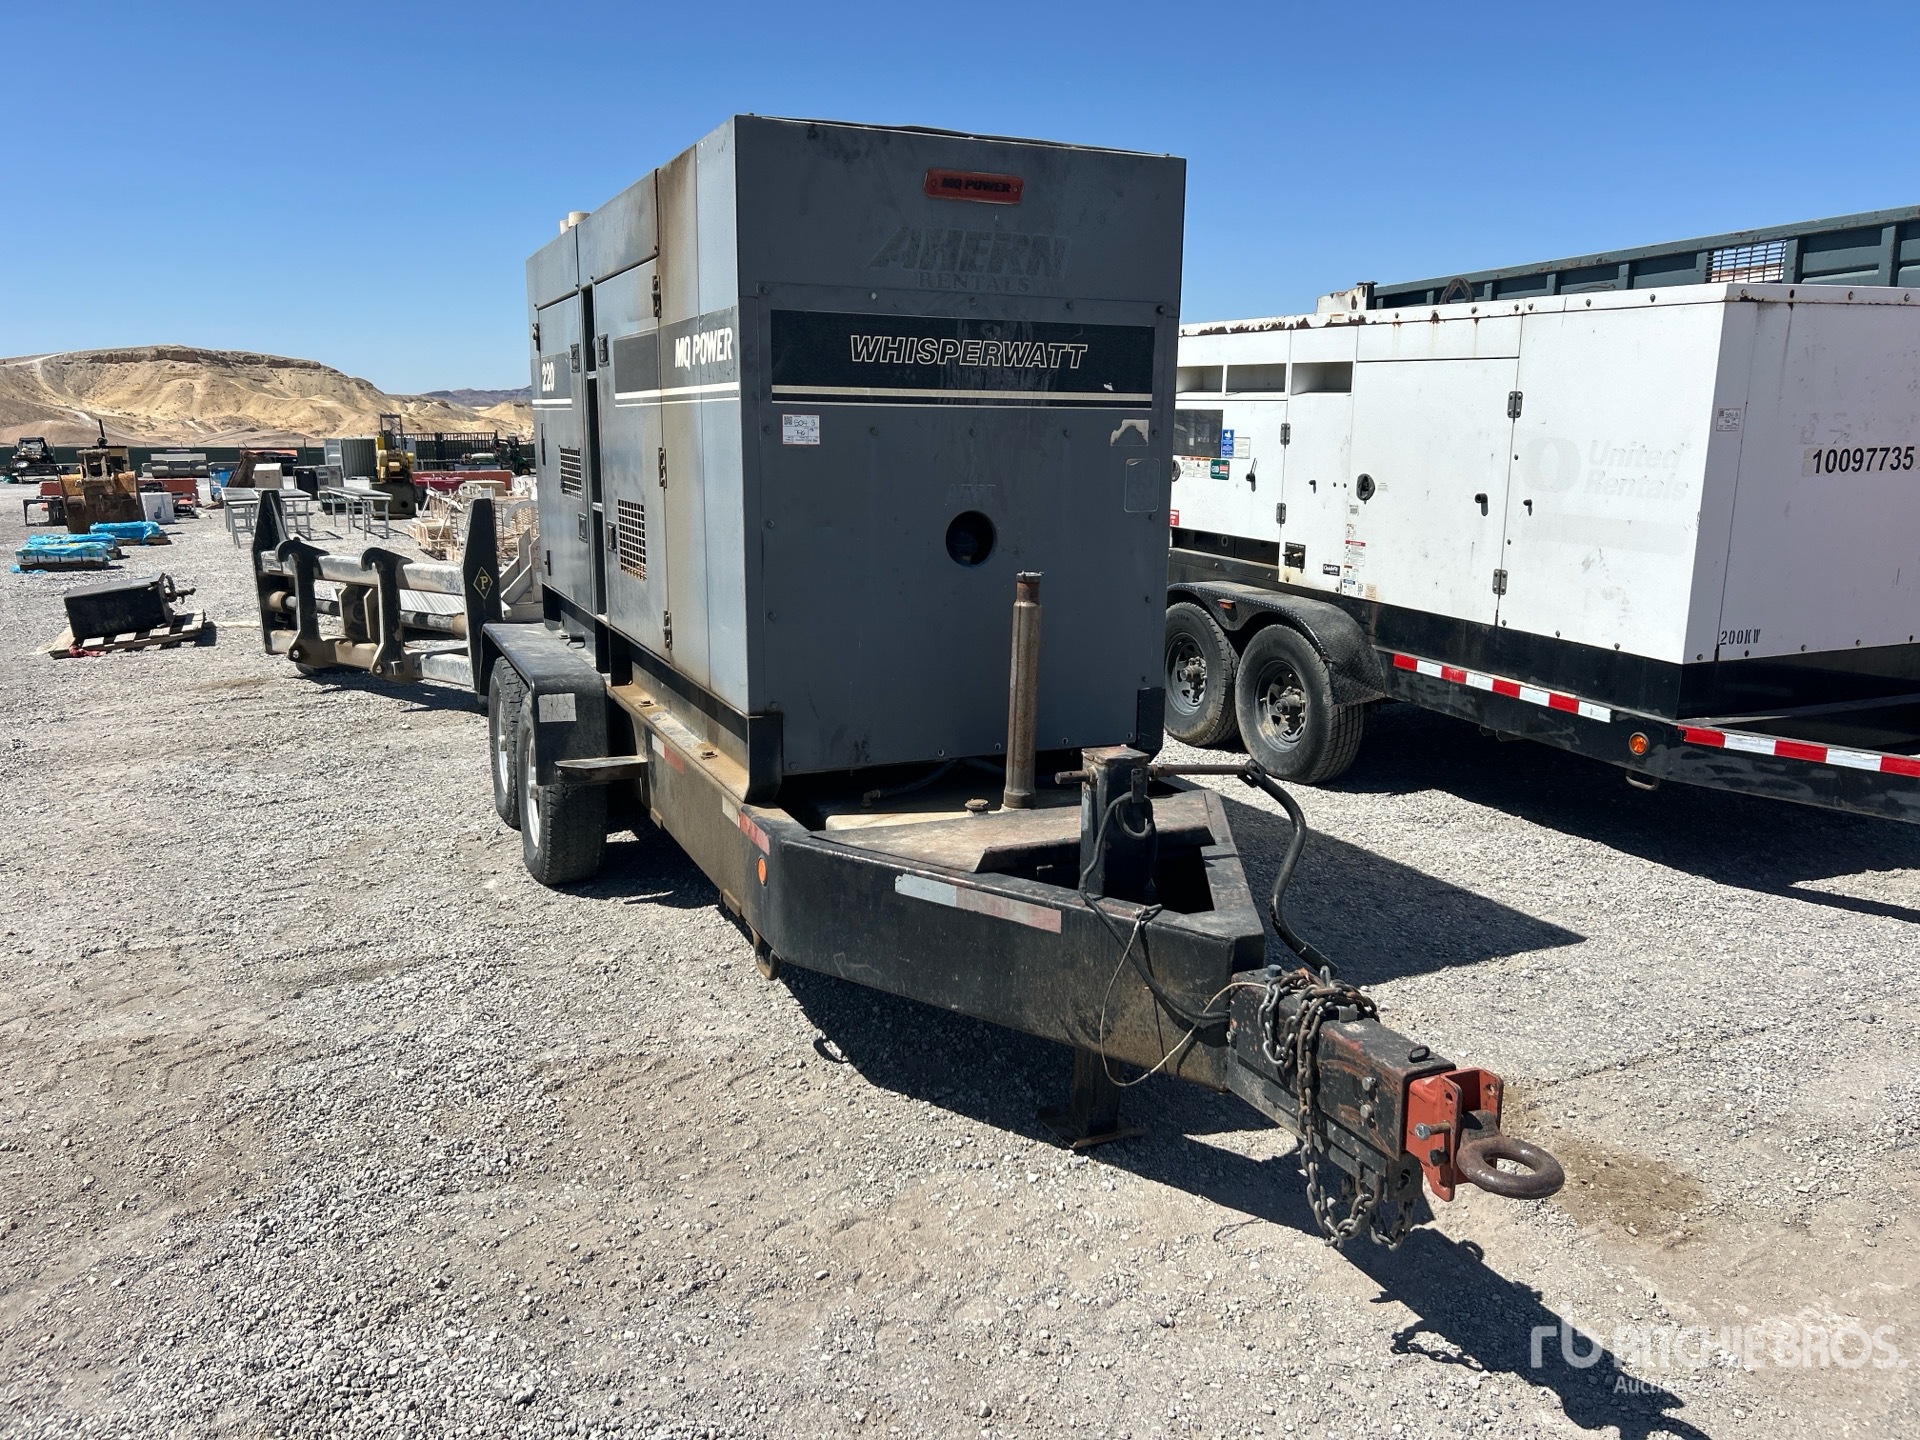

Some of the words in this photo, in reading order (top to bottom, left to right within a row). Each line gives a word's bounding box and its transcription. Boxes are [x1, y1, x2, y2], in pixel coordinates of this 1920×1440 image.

[965, 179, 1011, 193] POWER
[867, 226, 1071, 278] AHERN
[918, 271, 1031, 293] RENTALS
[675, 335, 691, 371] MQ
[692, 327, 733, 365] POWER
[850, 334, 1089, 369] WHISPERWATT
[541, 361, 555, 392] 220
[1589, 440, 1684, 469] United
[1812, 446, 1915, 474] 10097735
[1583, 469, 1689, 500] Rentals
[480, 576, 489, 590] P
[1720, 628, 1761, 645] 200KW
